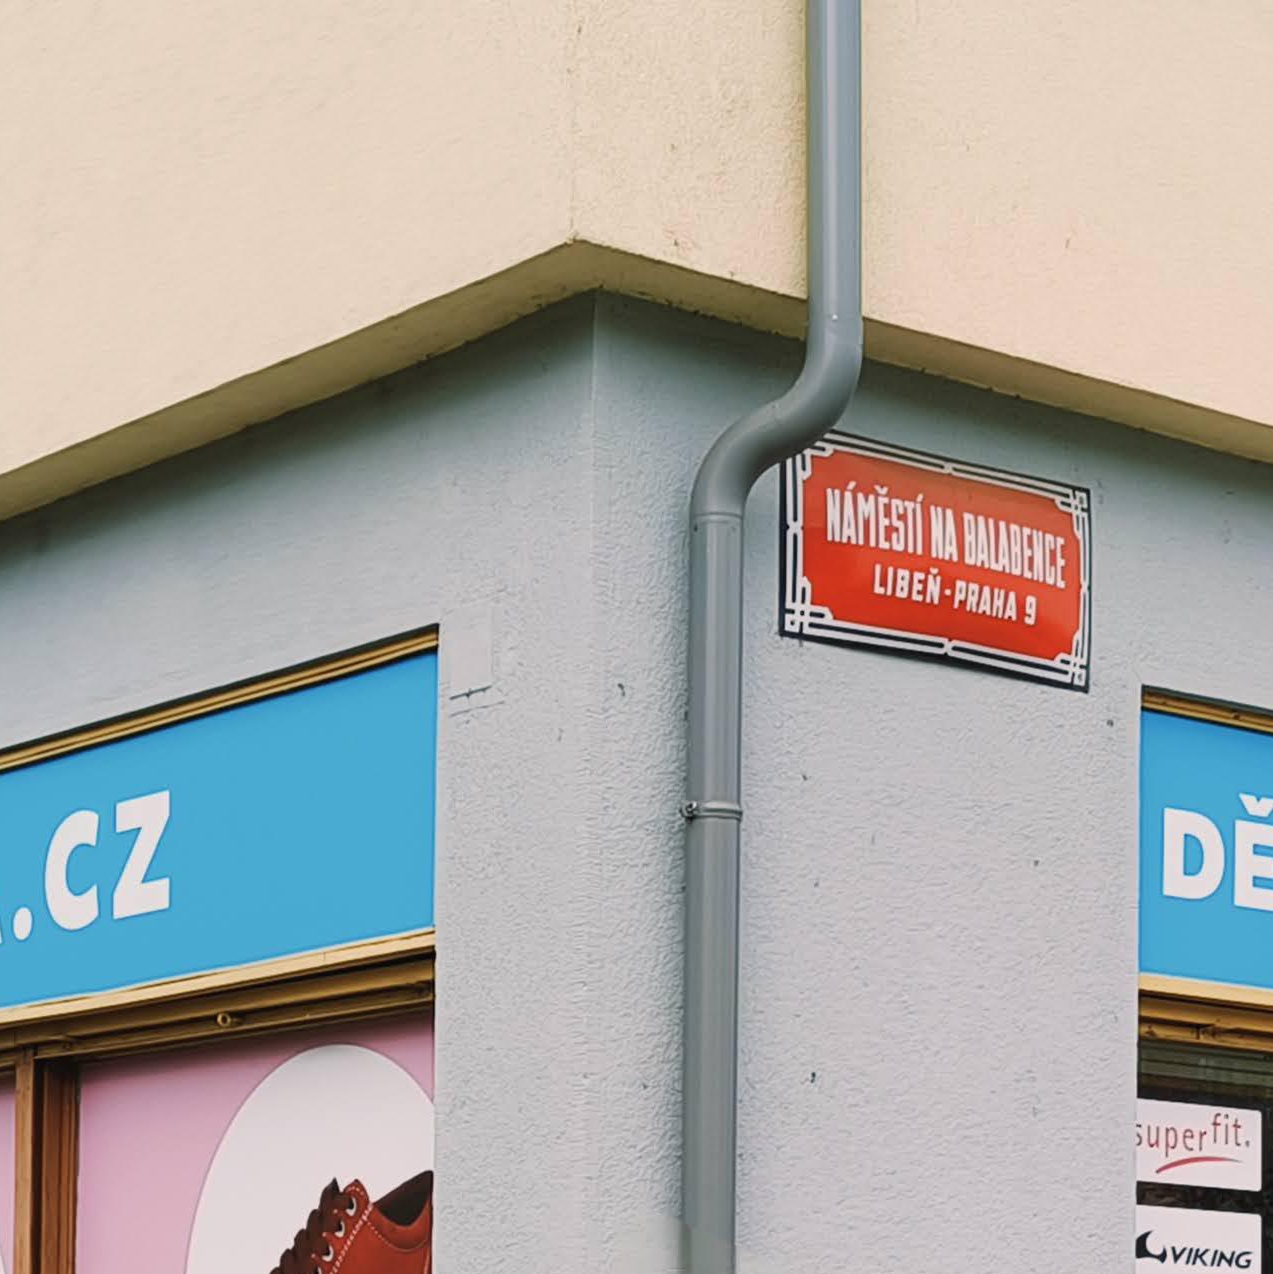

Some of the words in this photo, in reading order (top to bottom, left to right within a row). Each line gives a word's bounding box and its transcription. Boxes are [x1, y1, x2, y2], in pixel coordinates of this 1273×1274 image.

[826, 480, 924, 556] NÁMĚSTÍ
[930, 505, 958, 562] NA
[963, 511, 1066, 589] BALABENCE
[1025, 595, 1037, 625] 9
[1171, 1246, 1254, 1269] VIKING
